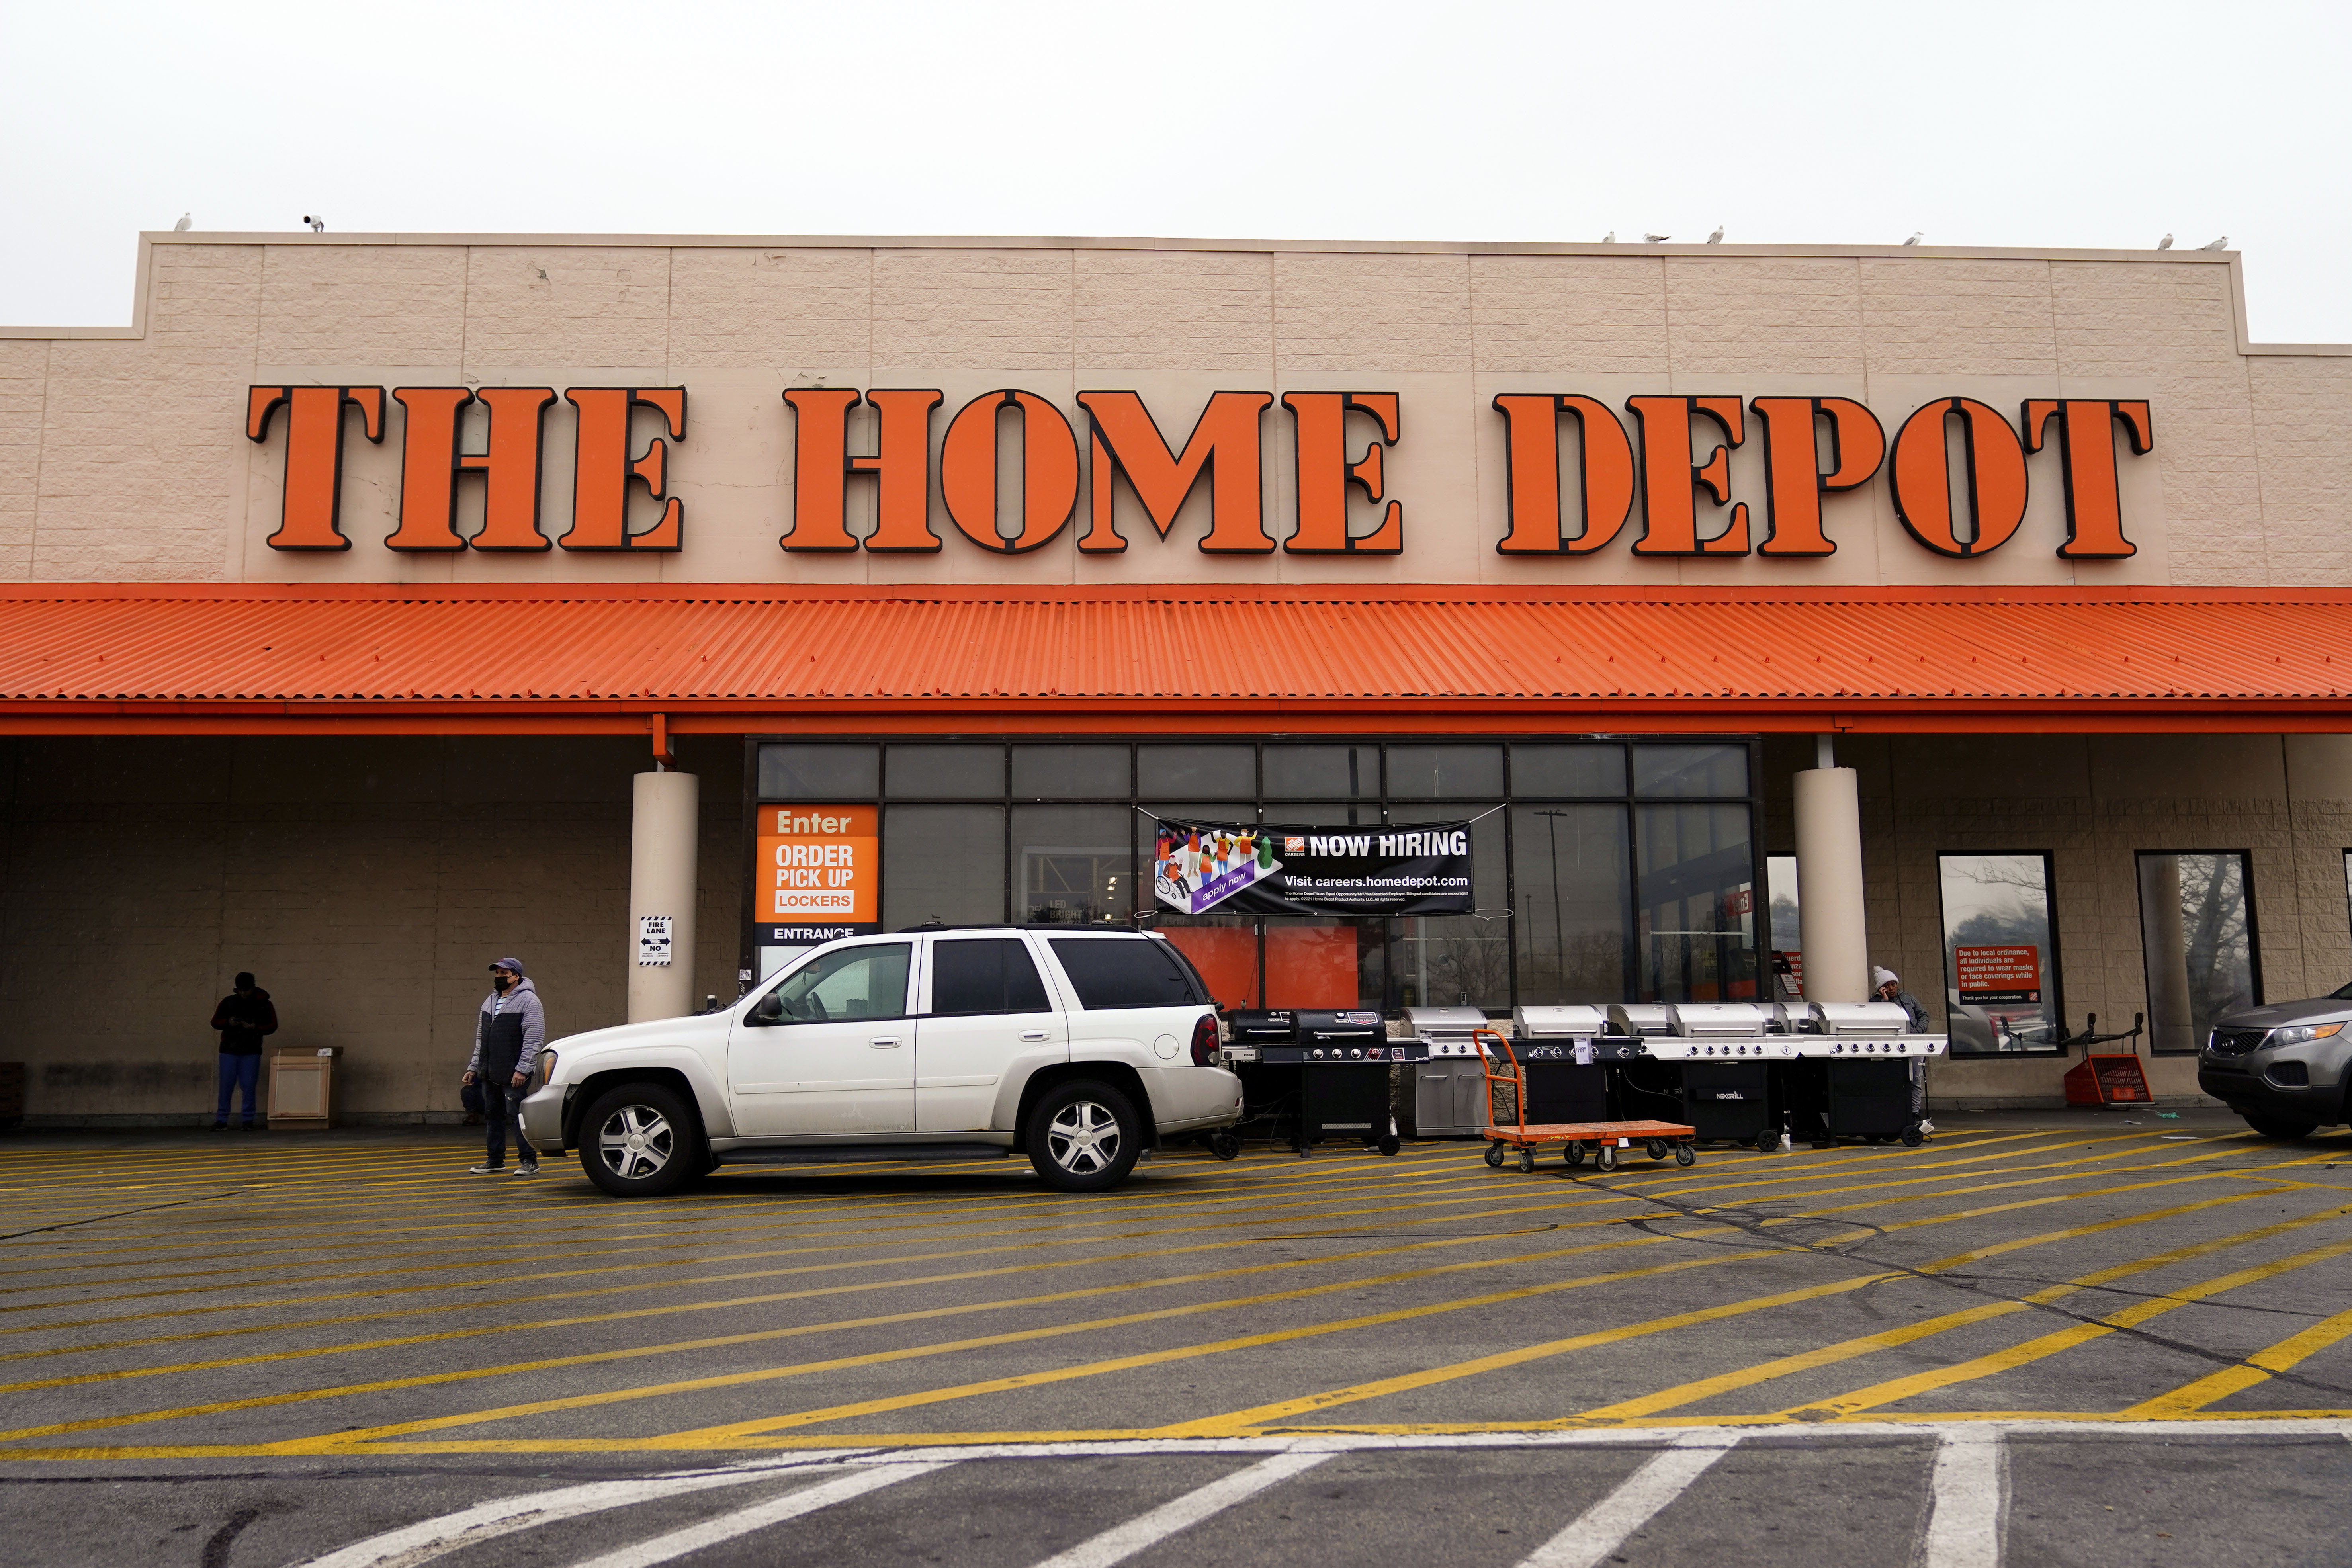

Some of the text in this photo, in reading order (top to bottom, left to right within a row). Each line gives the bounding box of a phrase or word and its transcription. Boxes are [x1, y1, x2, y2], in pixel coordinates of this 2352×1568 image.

[246, 385, 2153, 559] THE HOME DEPOT
[778, 811, 852, 833] Enter
[1310, 831, 1466, 856] NOW HIRING
[776, 845, 853, 867] ORDER
[777, 868, 853, 887] PICK UP
[1202, 872, 1246, 901] apply now
[1285, 876, 1468, 888] Visit careers.homedepot.com
[779, 895, 850, 907] LOCKERS
[1050, 900, 1066, 909] LED
[1050, 910, 1083, 919] BRIGHT
